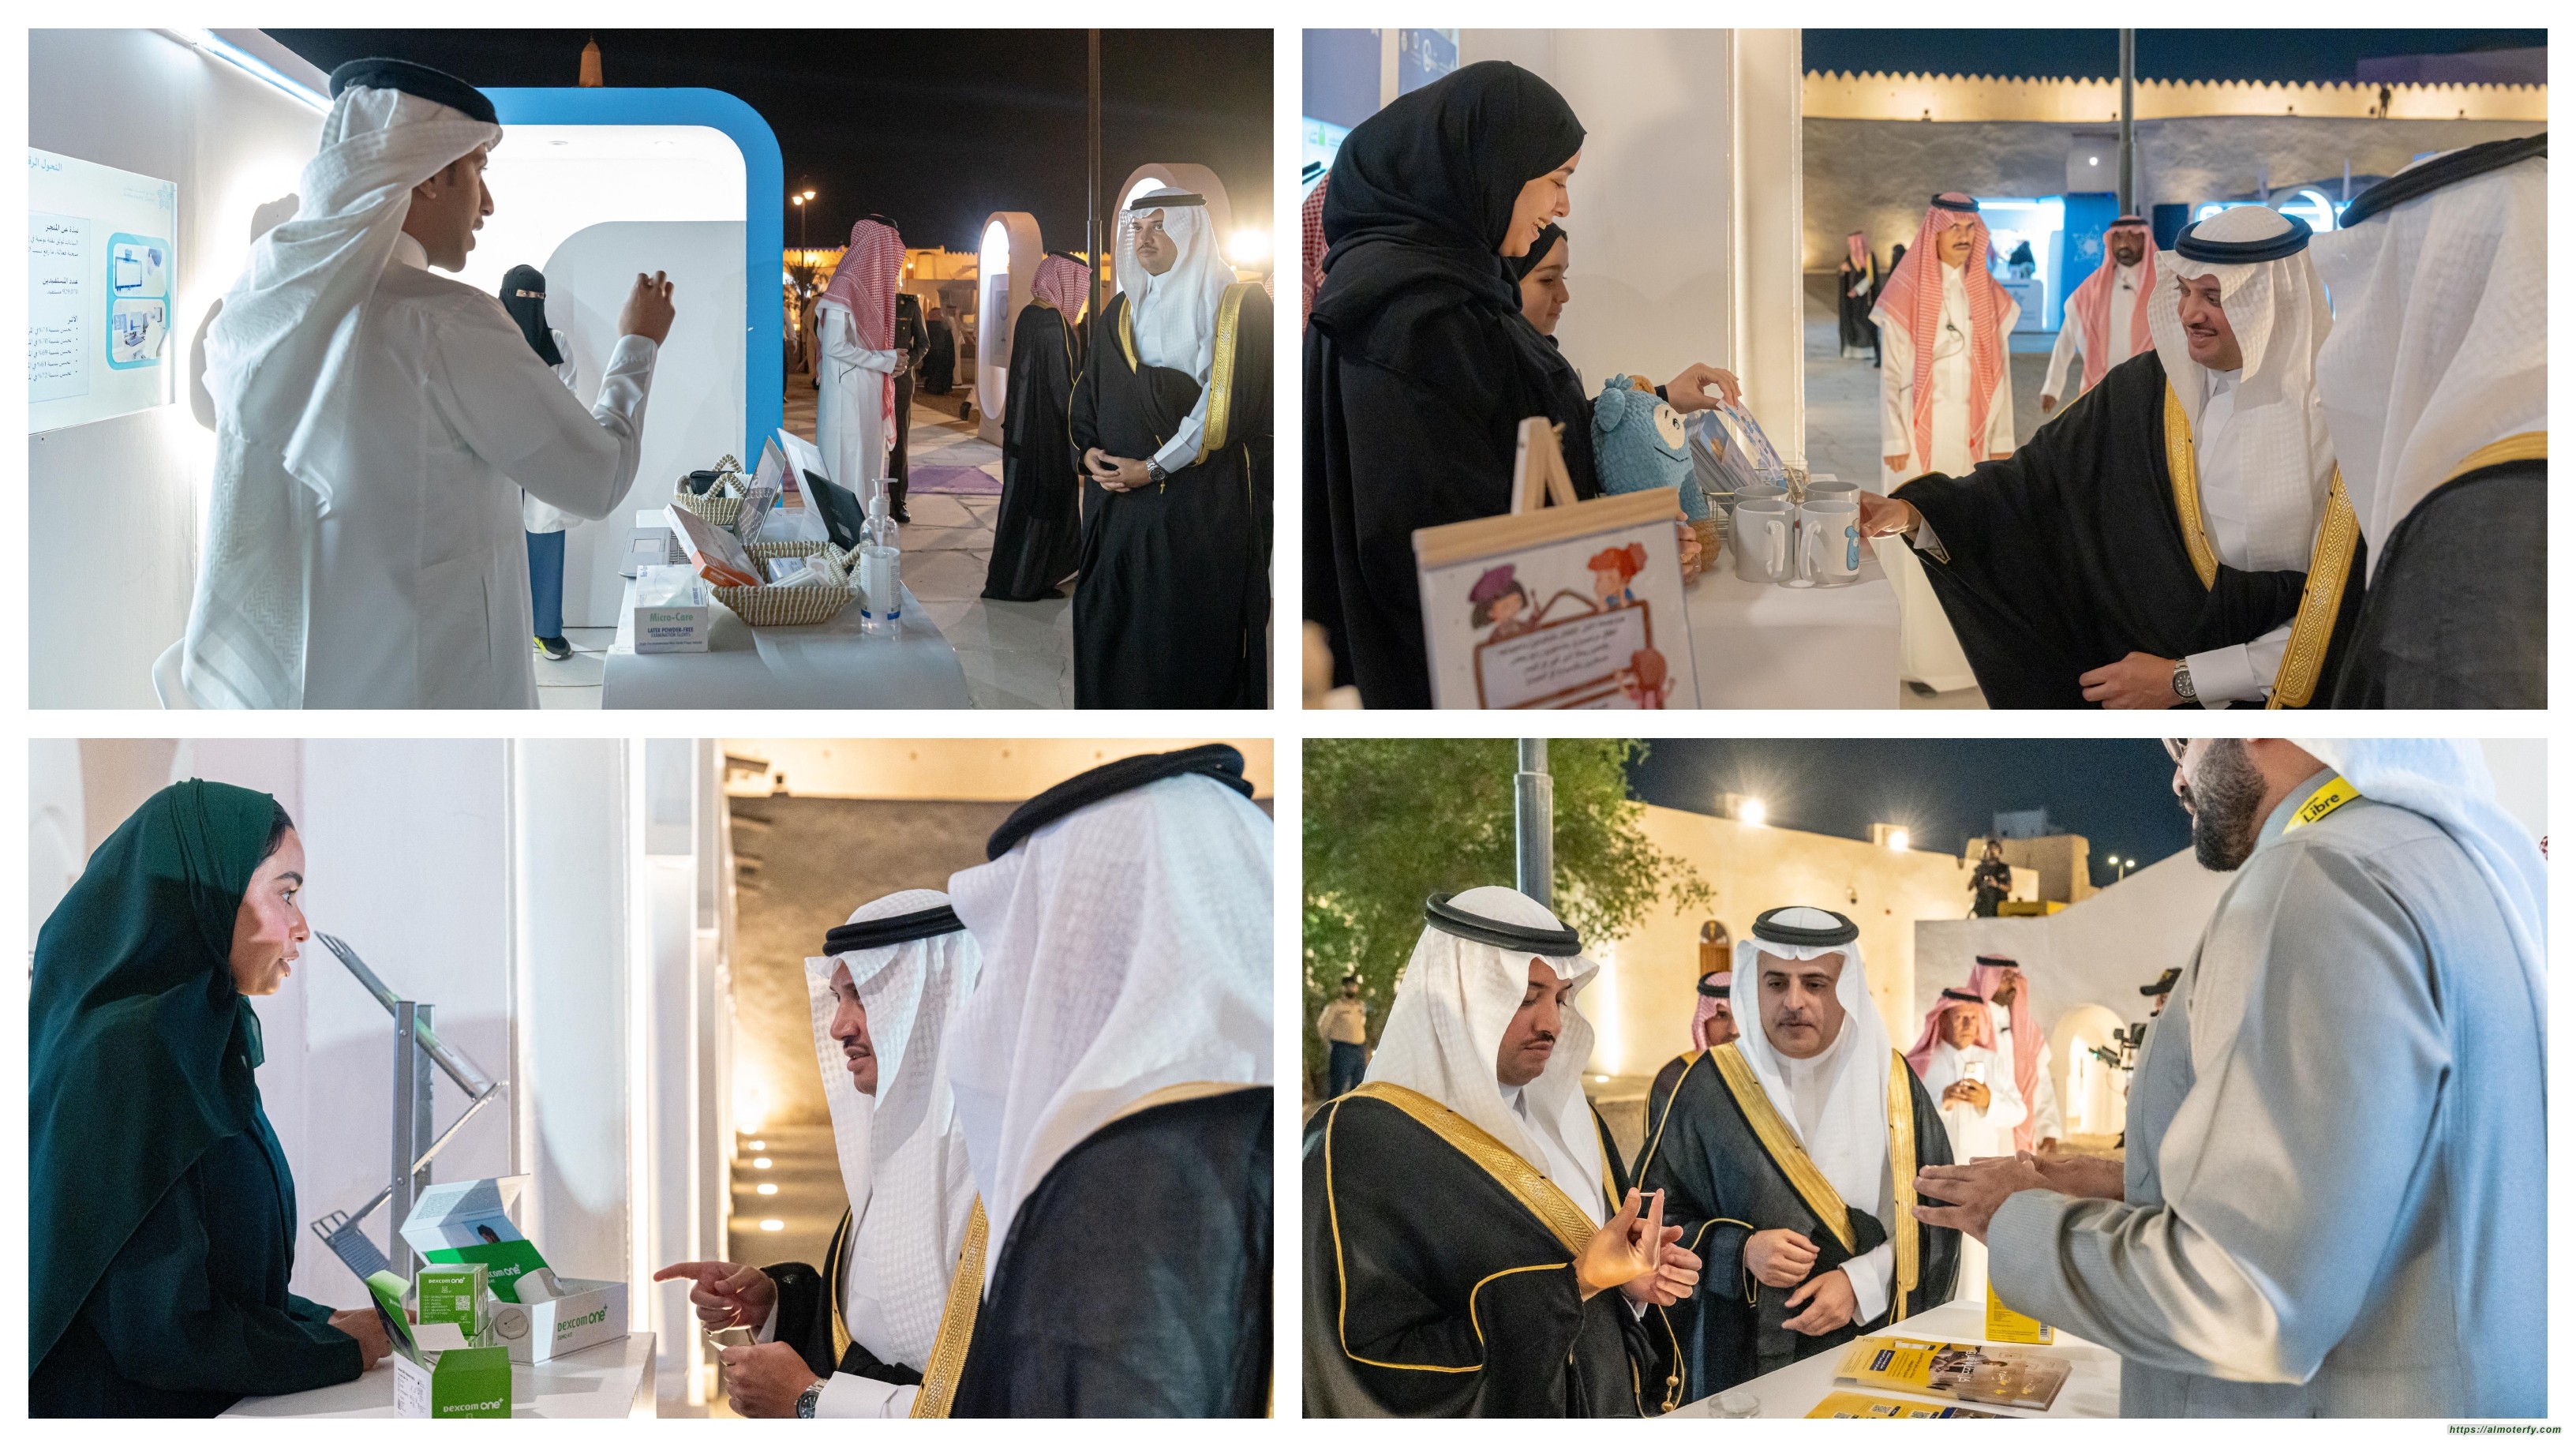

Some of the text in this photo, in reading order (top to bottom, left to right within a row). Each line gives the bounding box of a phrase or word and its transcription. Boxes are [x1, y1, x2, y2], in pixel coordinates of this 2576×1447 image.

[41, 159, 62, 171] التحول
[650, 612, 694, 622] Micro-Care
[2303, 794, 2340, 823] Libre
